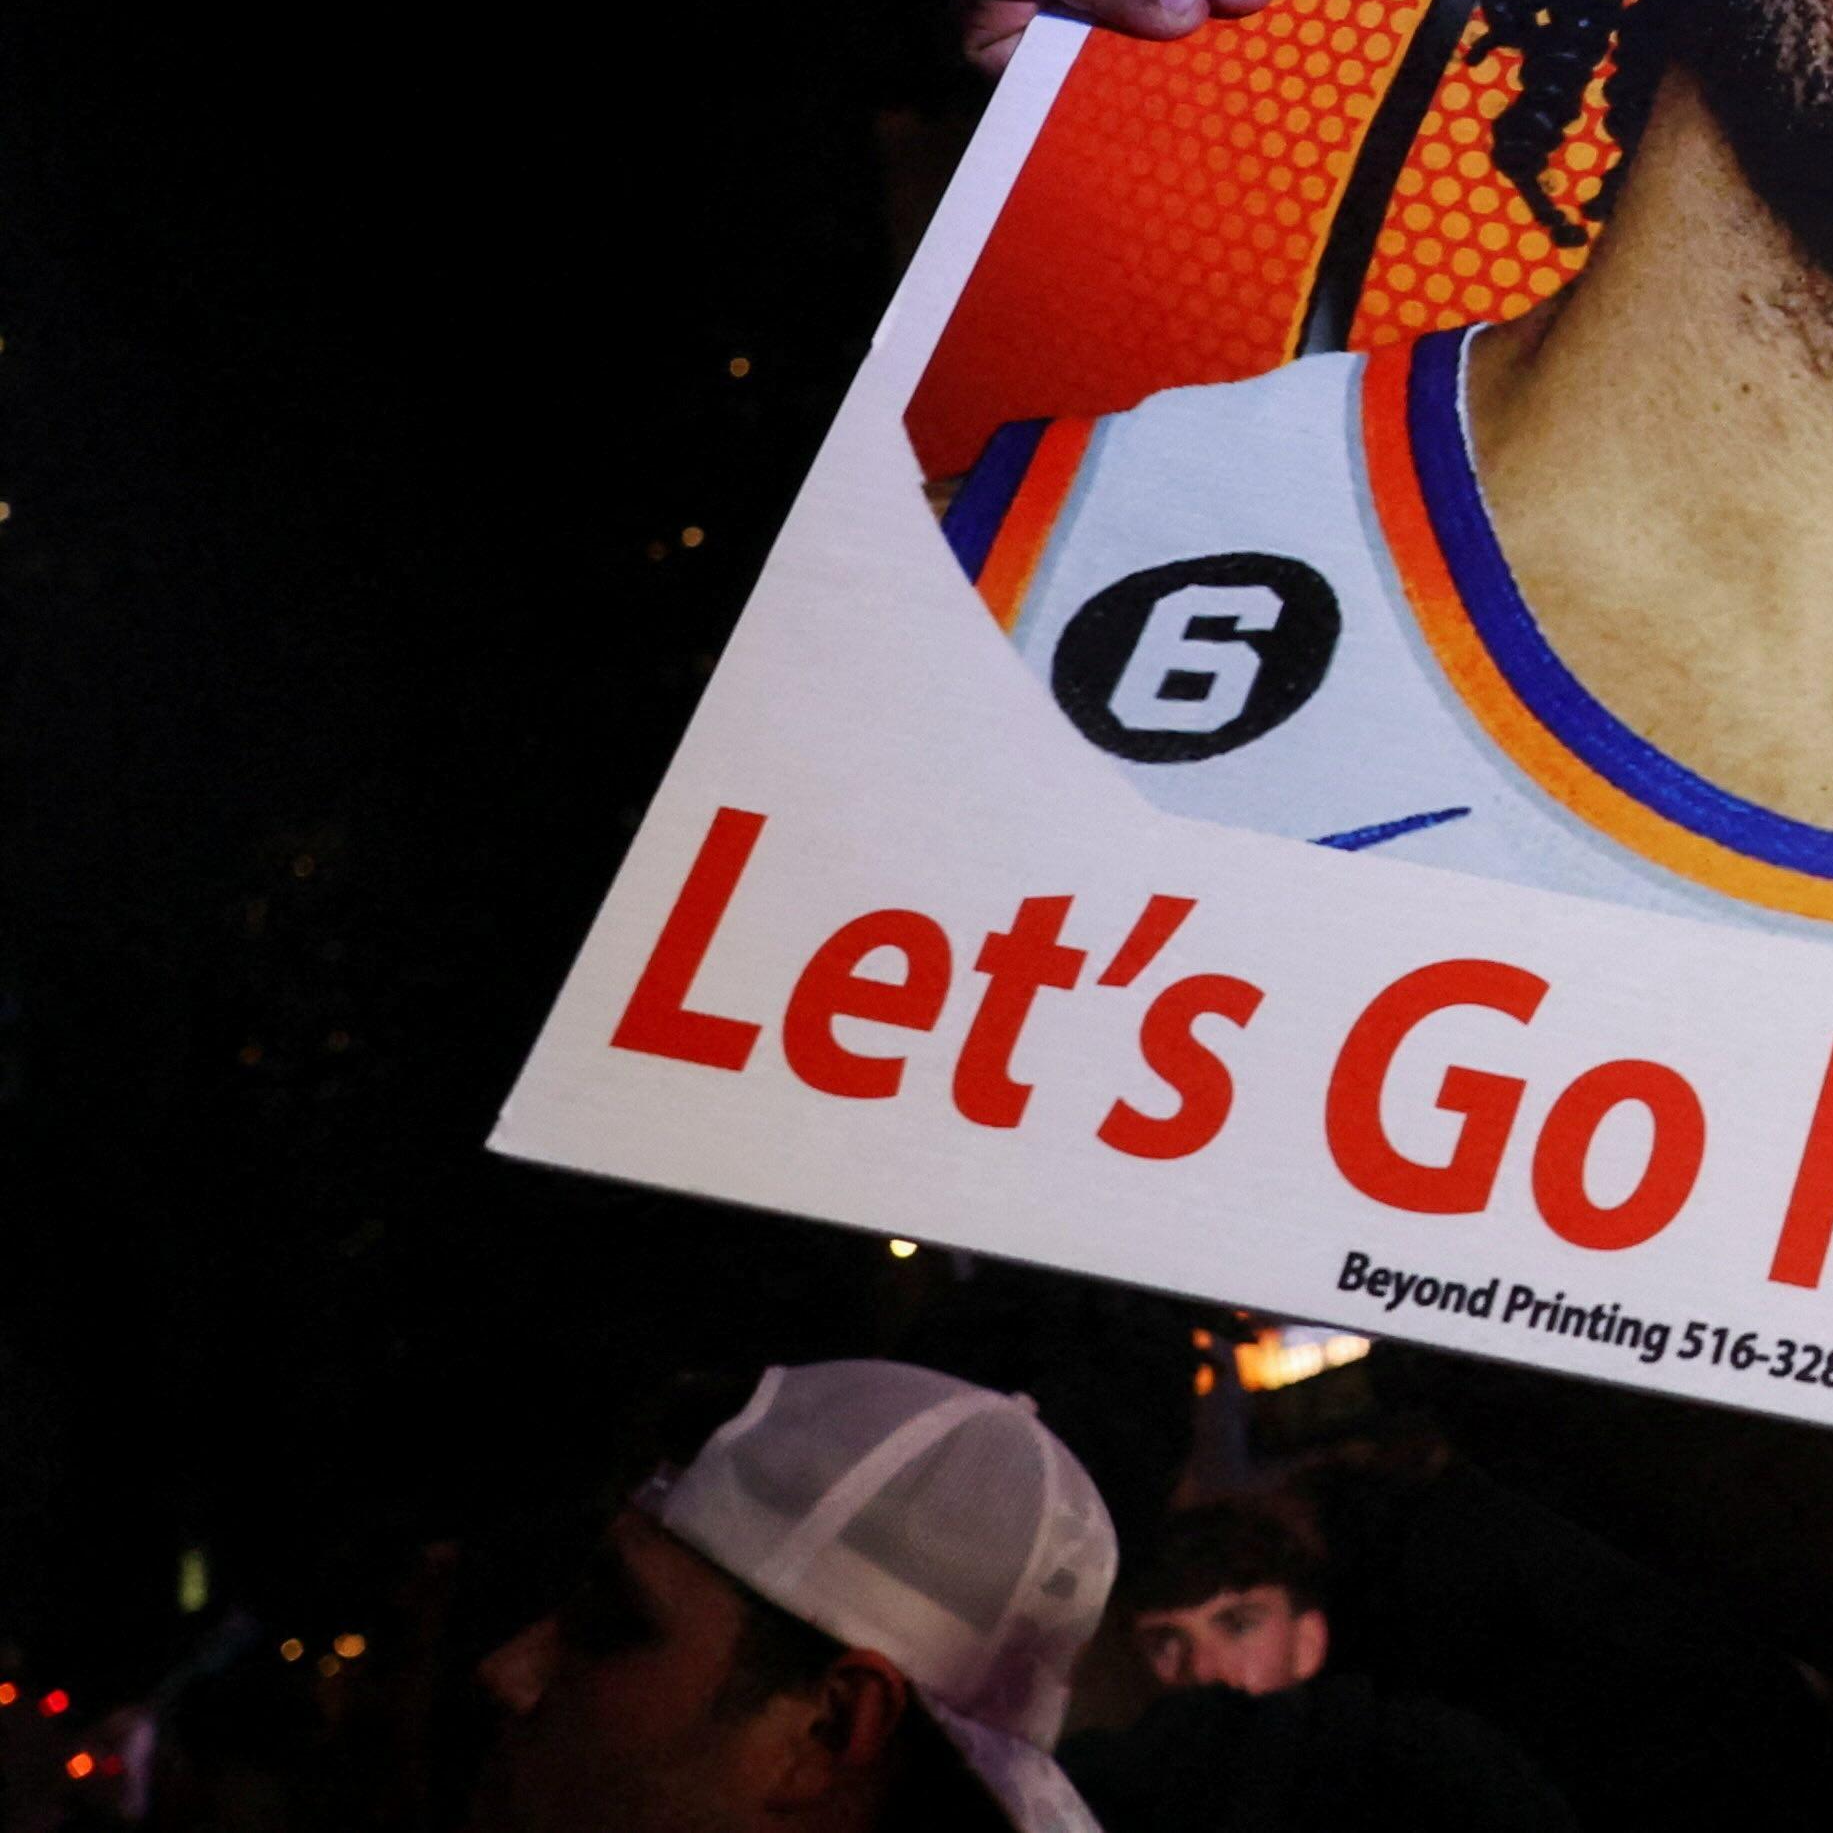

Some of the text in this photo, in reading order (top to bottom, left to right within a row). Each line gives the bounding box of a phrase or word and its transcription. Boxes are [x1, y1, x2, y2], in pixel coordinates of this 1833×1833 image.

[1106, 582, 1286, 734] 6
[611, 807, 1264, 1160] Let's
[1325, 959, 1706, 1251] Go
[1337, 1251, 1500, 1320] Beyond
[1502, 1284, 1671, 1365] Printing
